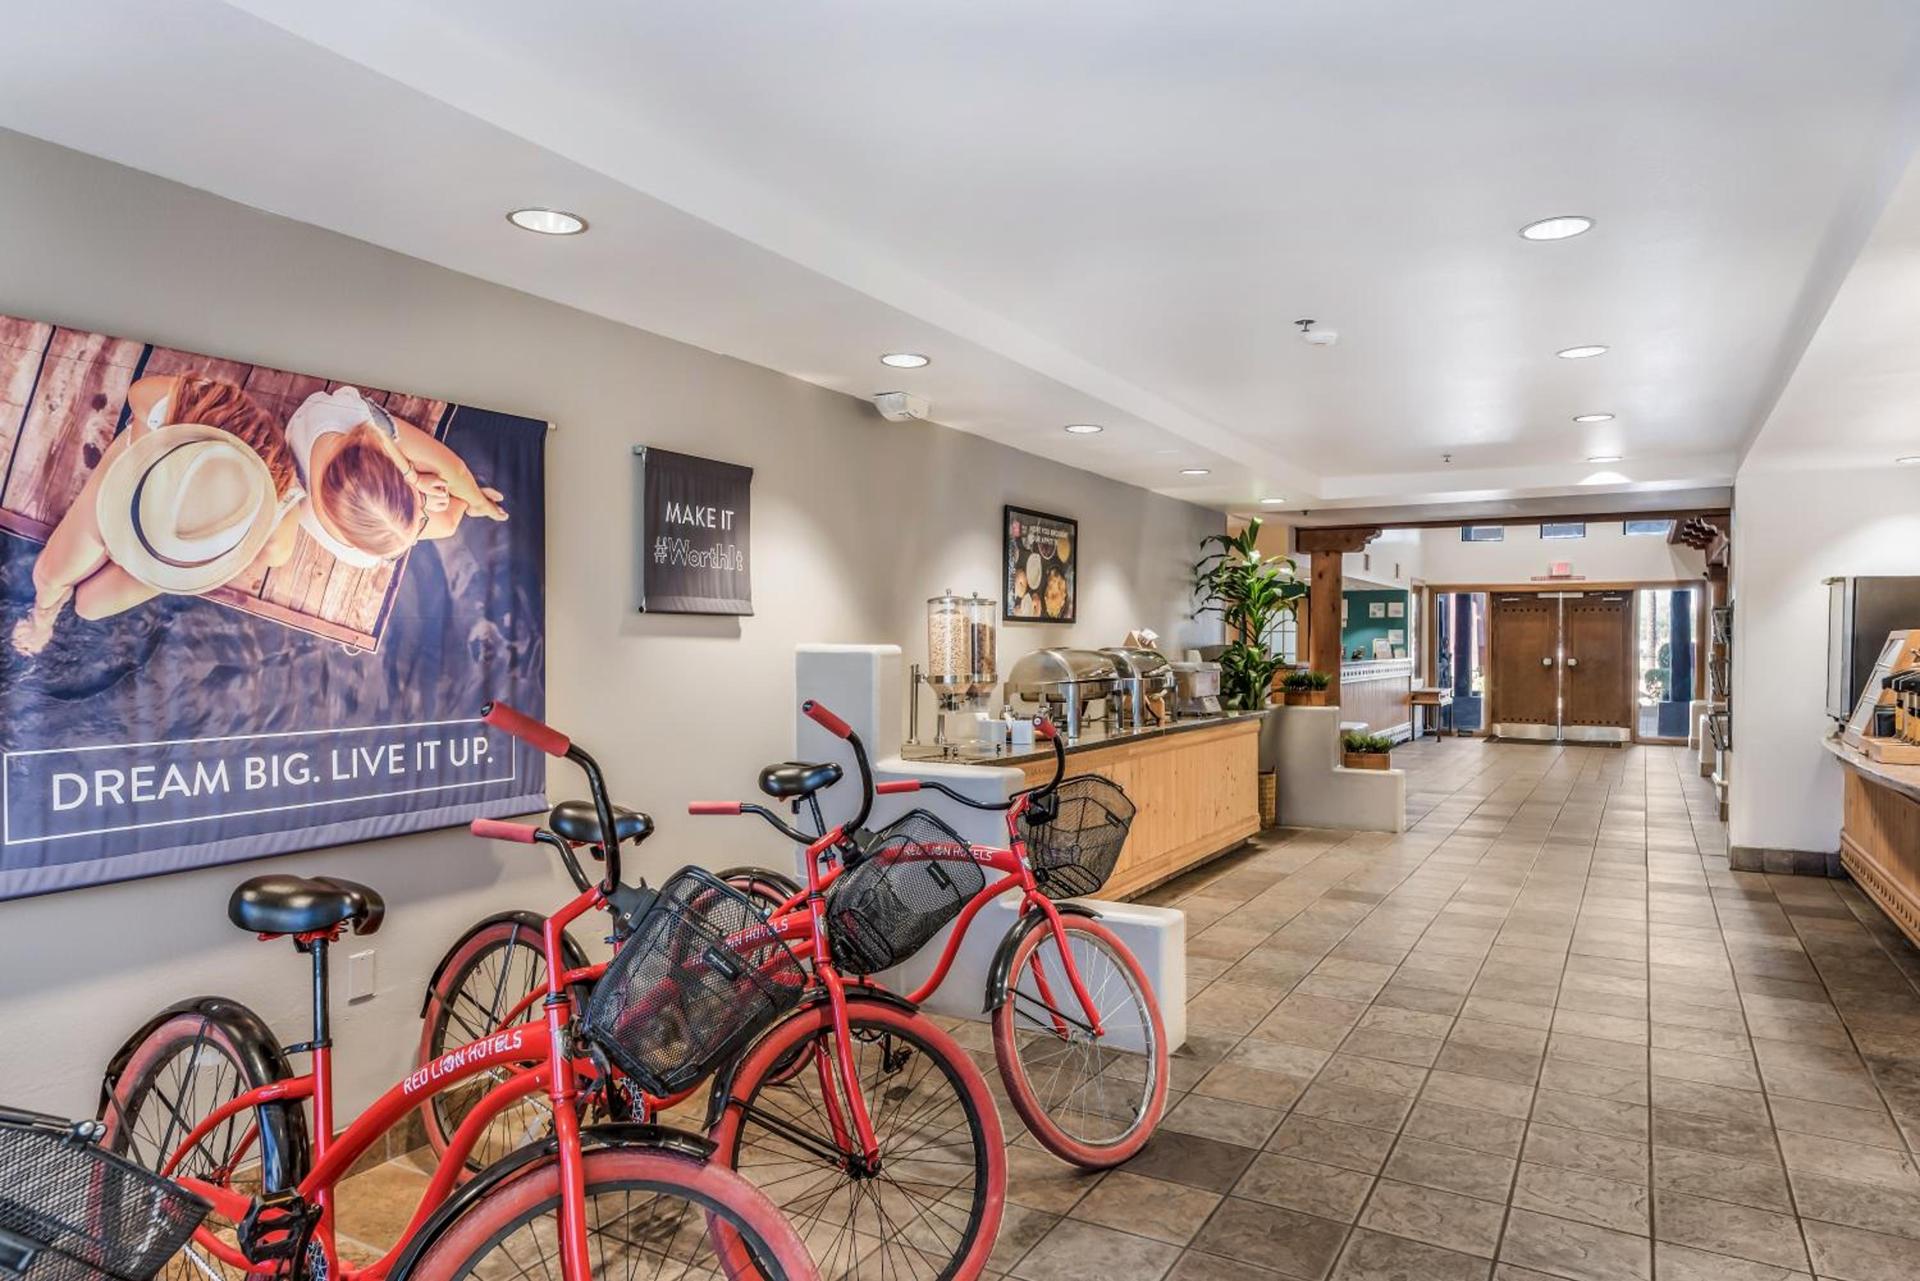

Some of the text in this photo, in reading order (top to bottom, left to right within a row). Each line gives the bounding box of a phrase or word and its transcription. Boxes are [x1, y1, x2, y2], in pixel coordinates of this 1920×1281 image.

[665, 501, 735, 530] MAKE IT
[653, 536, 744, 571] #WorthIt
[52, 736, 494, 811] DREAM BIG. LIVE IT UP.
[403, 1030, 523, 1095] RED LION HOTELS
